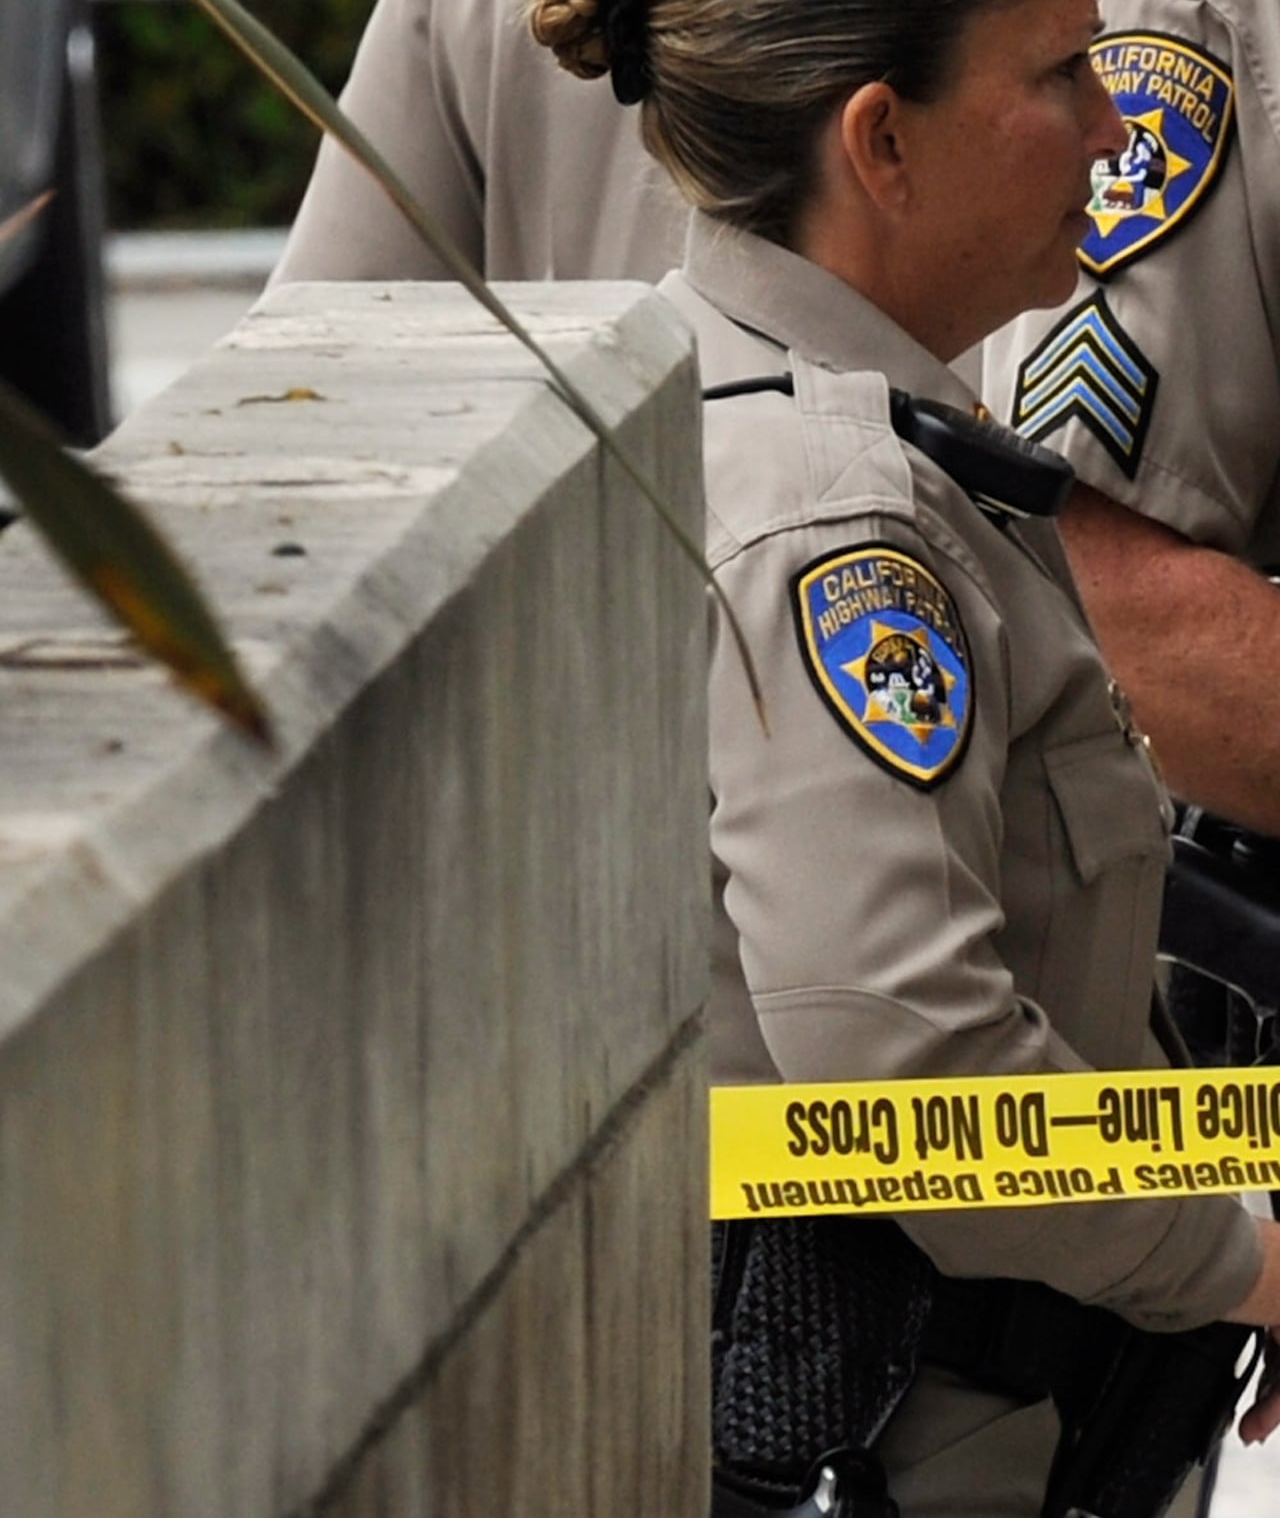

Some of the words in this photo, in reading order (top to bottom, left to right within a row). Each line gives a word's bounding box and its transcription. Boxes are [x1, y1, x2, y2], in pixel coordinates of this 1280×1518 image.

[1089, 45, 1214, 101] ALIFORNIA
[1147, 74, 1218, 143] PATROL
[822, 559, 948, 612] CALIFOR
[785, 1097, 898, 1165] Cross
[912, 1095, 983, 1161] Not
[742, 1171, 985, 1213] Department
[995, 1167, 1119, 1201] Police
